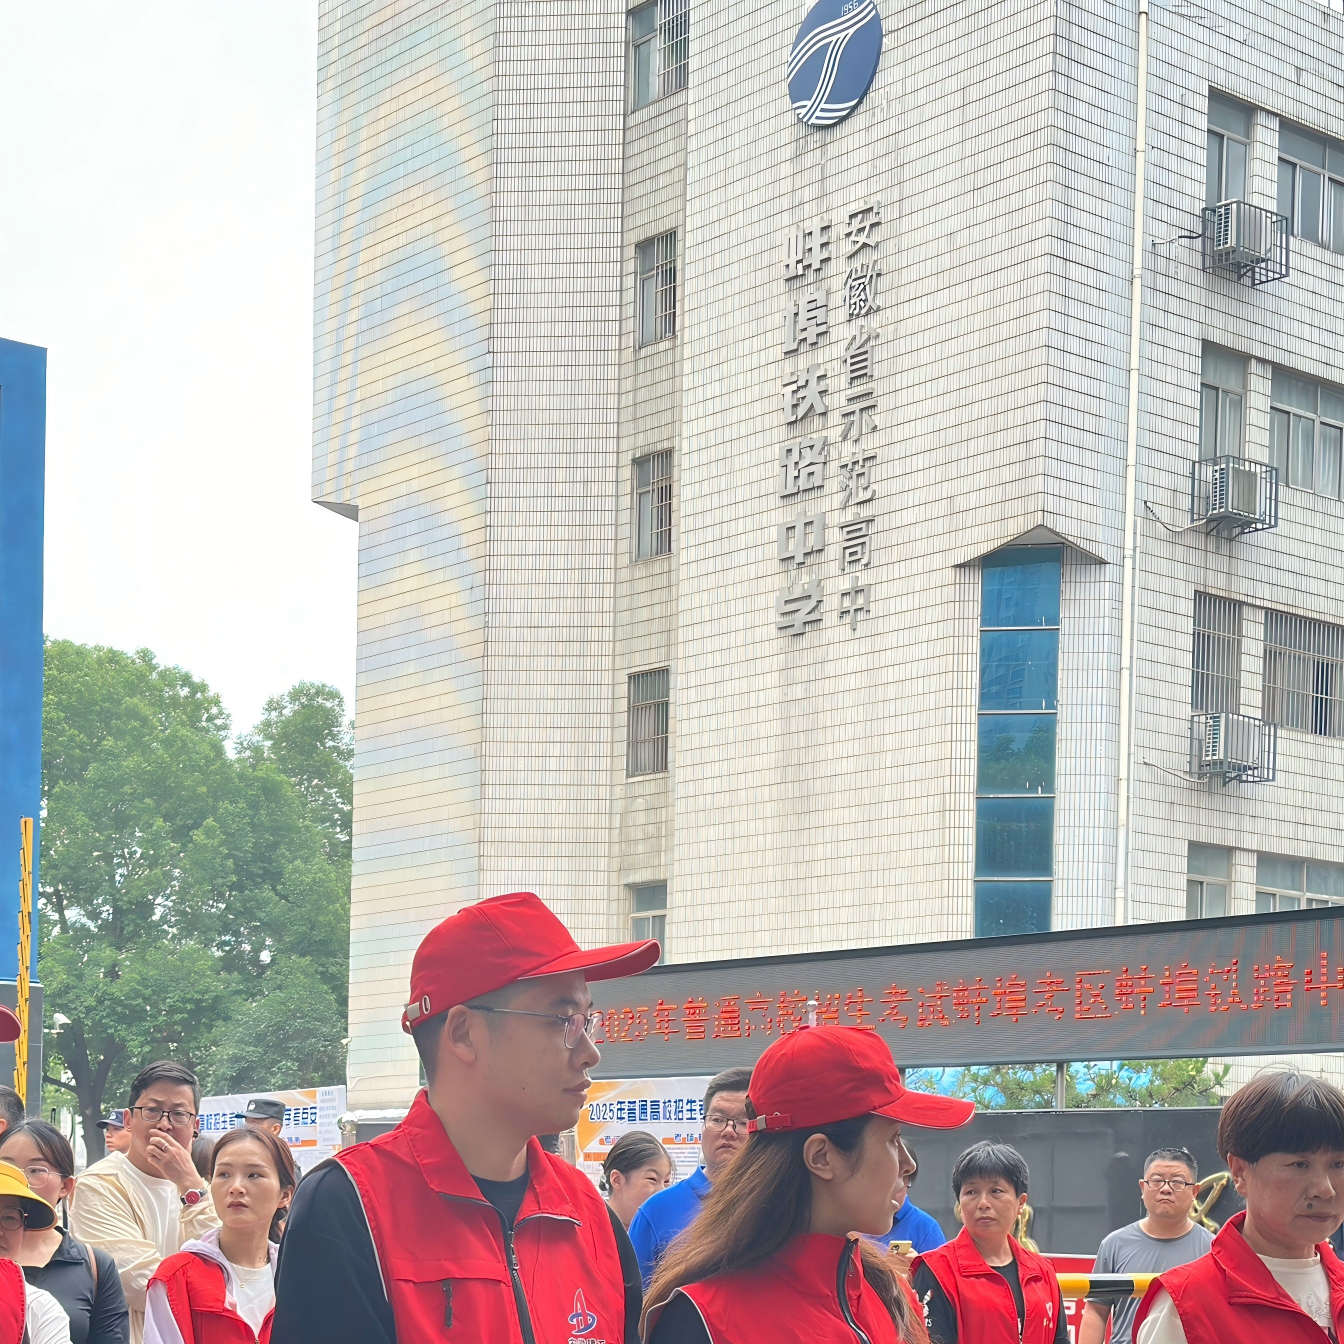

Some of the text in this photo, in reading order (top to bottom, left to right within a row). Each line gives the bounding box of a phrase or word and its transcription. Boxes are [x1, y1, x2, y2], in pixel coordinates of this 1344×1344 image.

[775, 216, 833, 636] 蚌埠铁路中学
[837, 200, 883, 631] 安徽省示范高中
